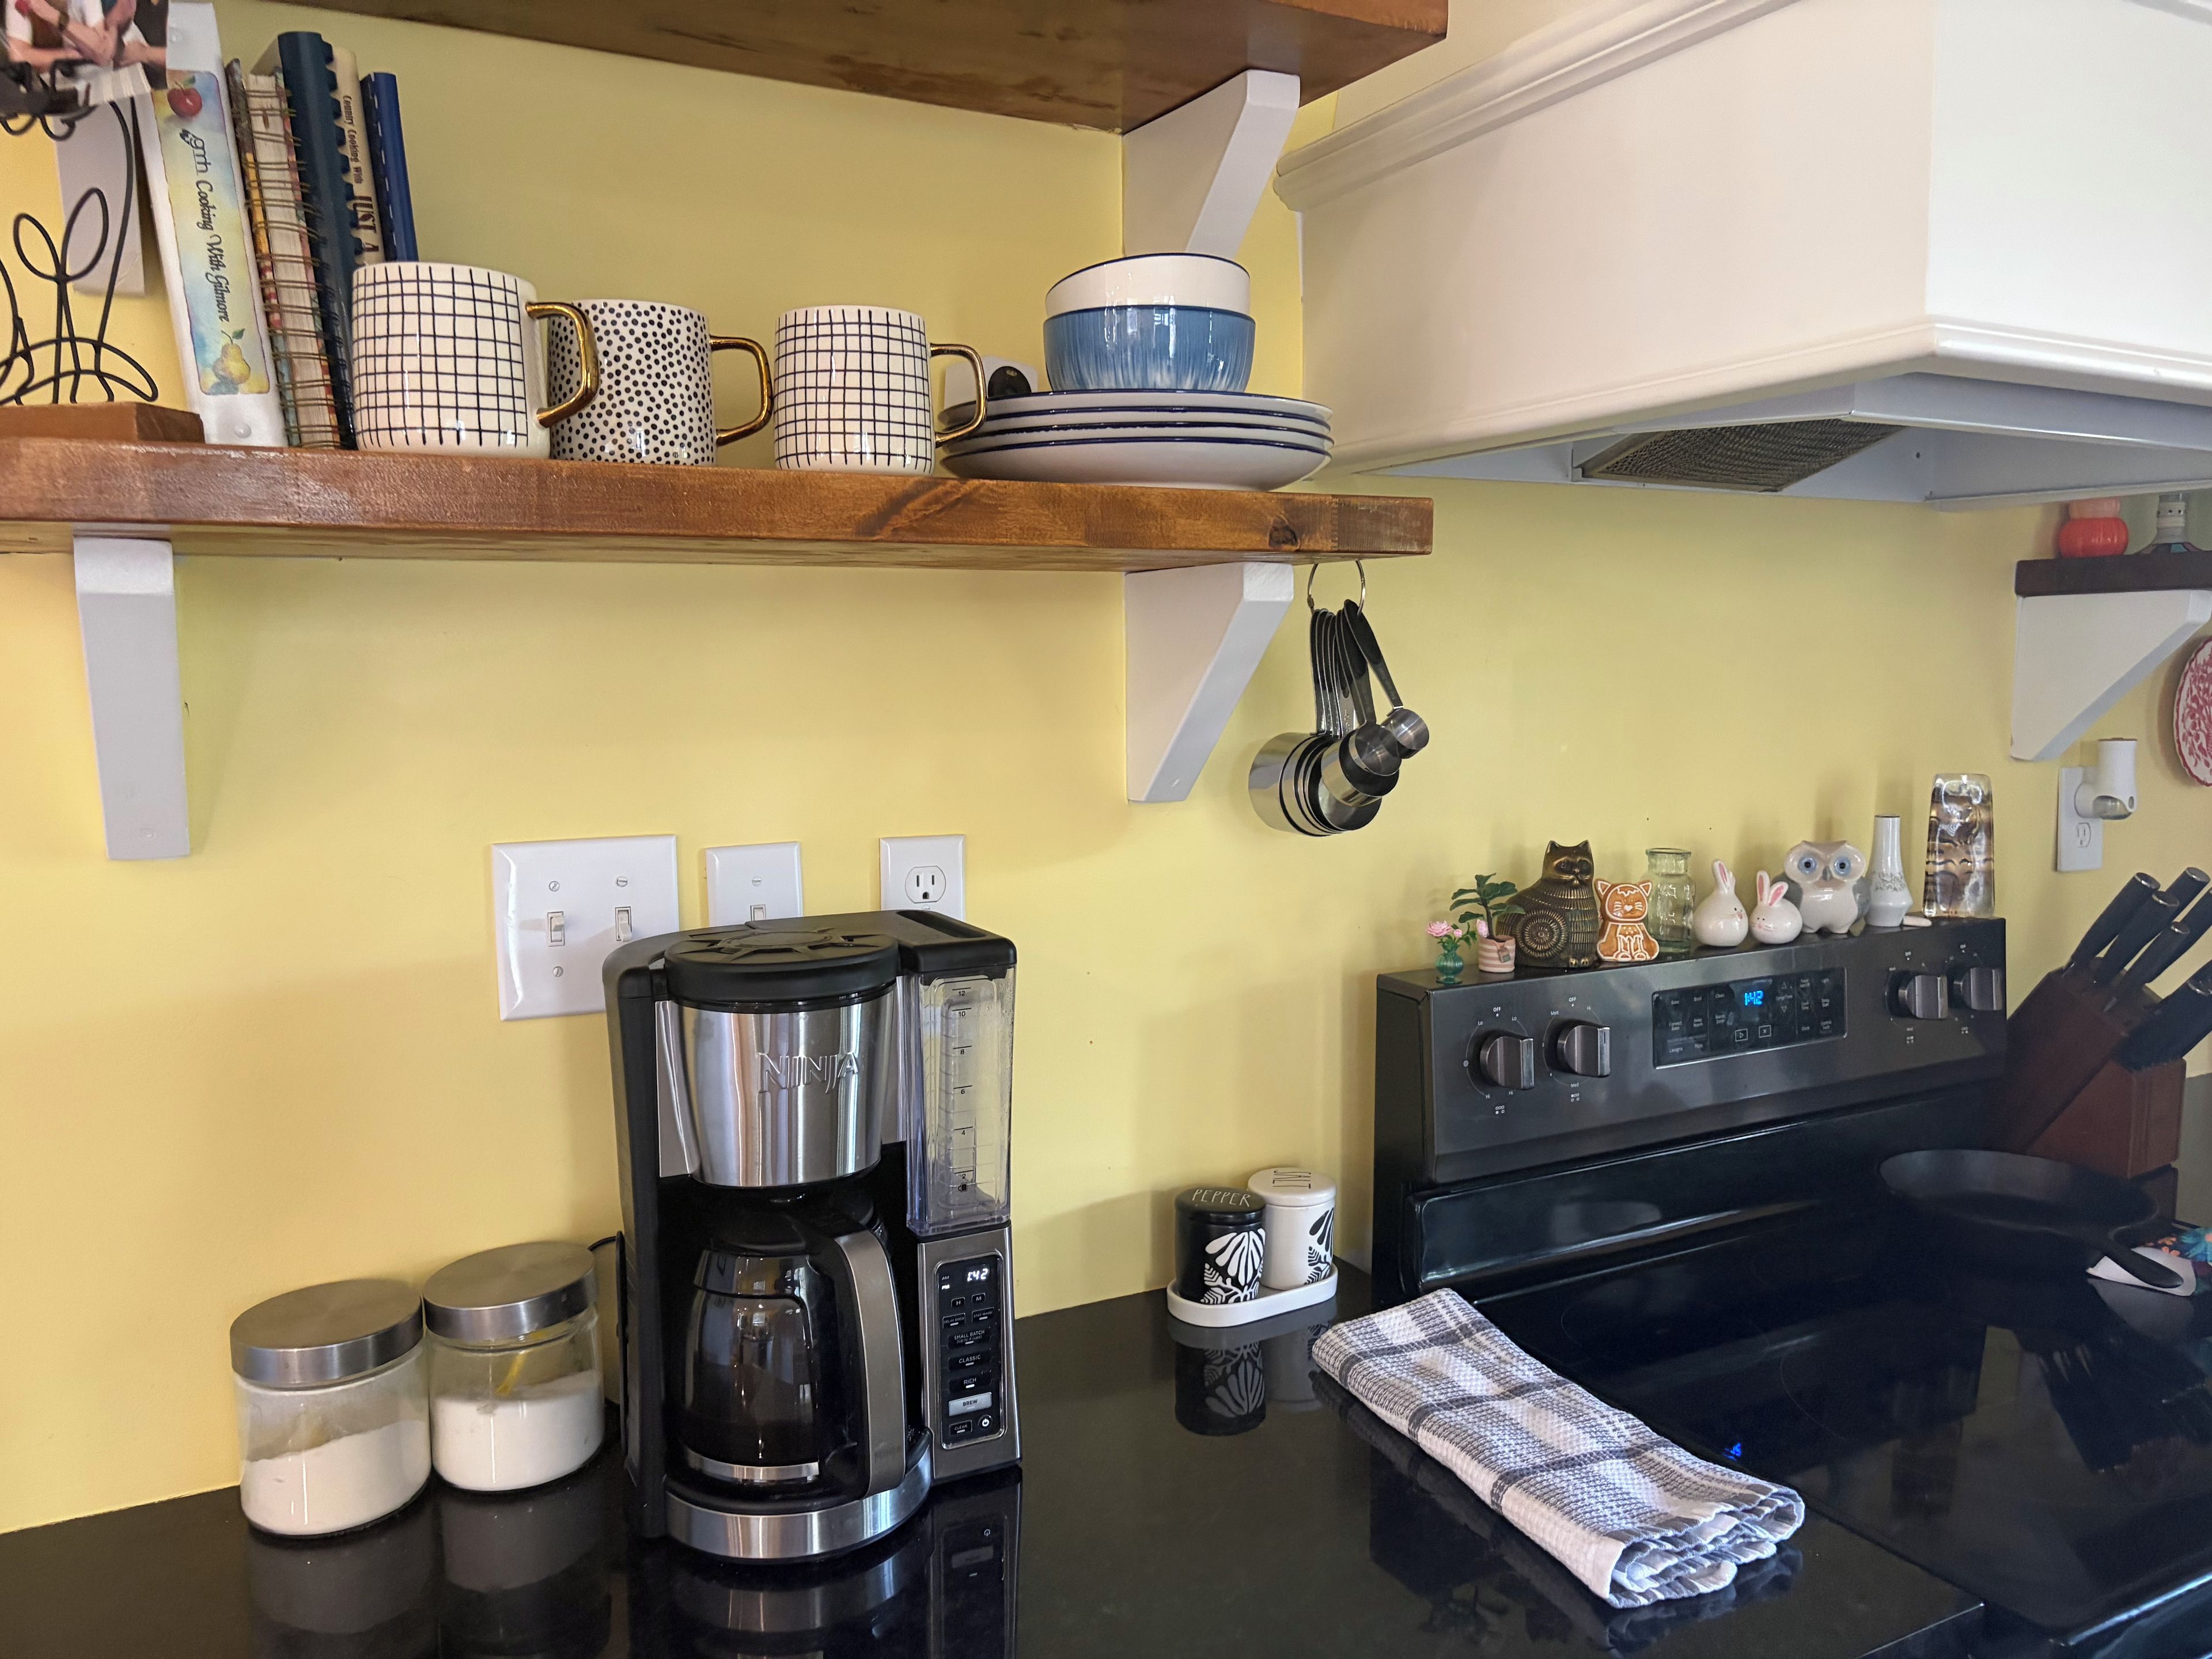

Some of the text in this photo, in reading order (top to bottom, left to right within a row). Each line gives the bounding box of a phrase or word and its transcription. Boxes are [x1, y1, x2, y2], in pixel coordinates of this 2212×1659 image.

[343, 96, 364, 184] Country Cooking With
[196, 180, 217, 231] Cooking
[206, 234, 226, 272] With
[204, 272, 231, 323] Gilmore
[1744, 990, 1764, 1006] 1:42
[757, 1052, 860, 1093] NINJA
[1192, 1189, 1251, 1207] PEPPER
[959, 1354, 982, 1364] CLASSIC
[963, 1377, 977, 1385] RICH
[963, 1399, 978, 1407] BREW
